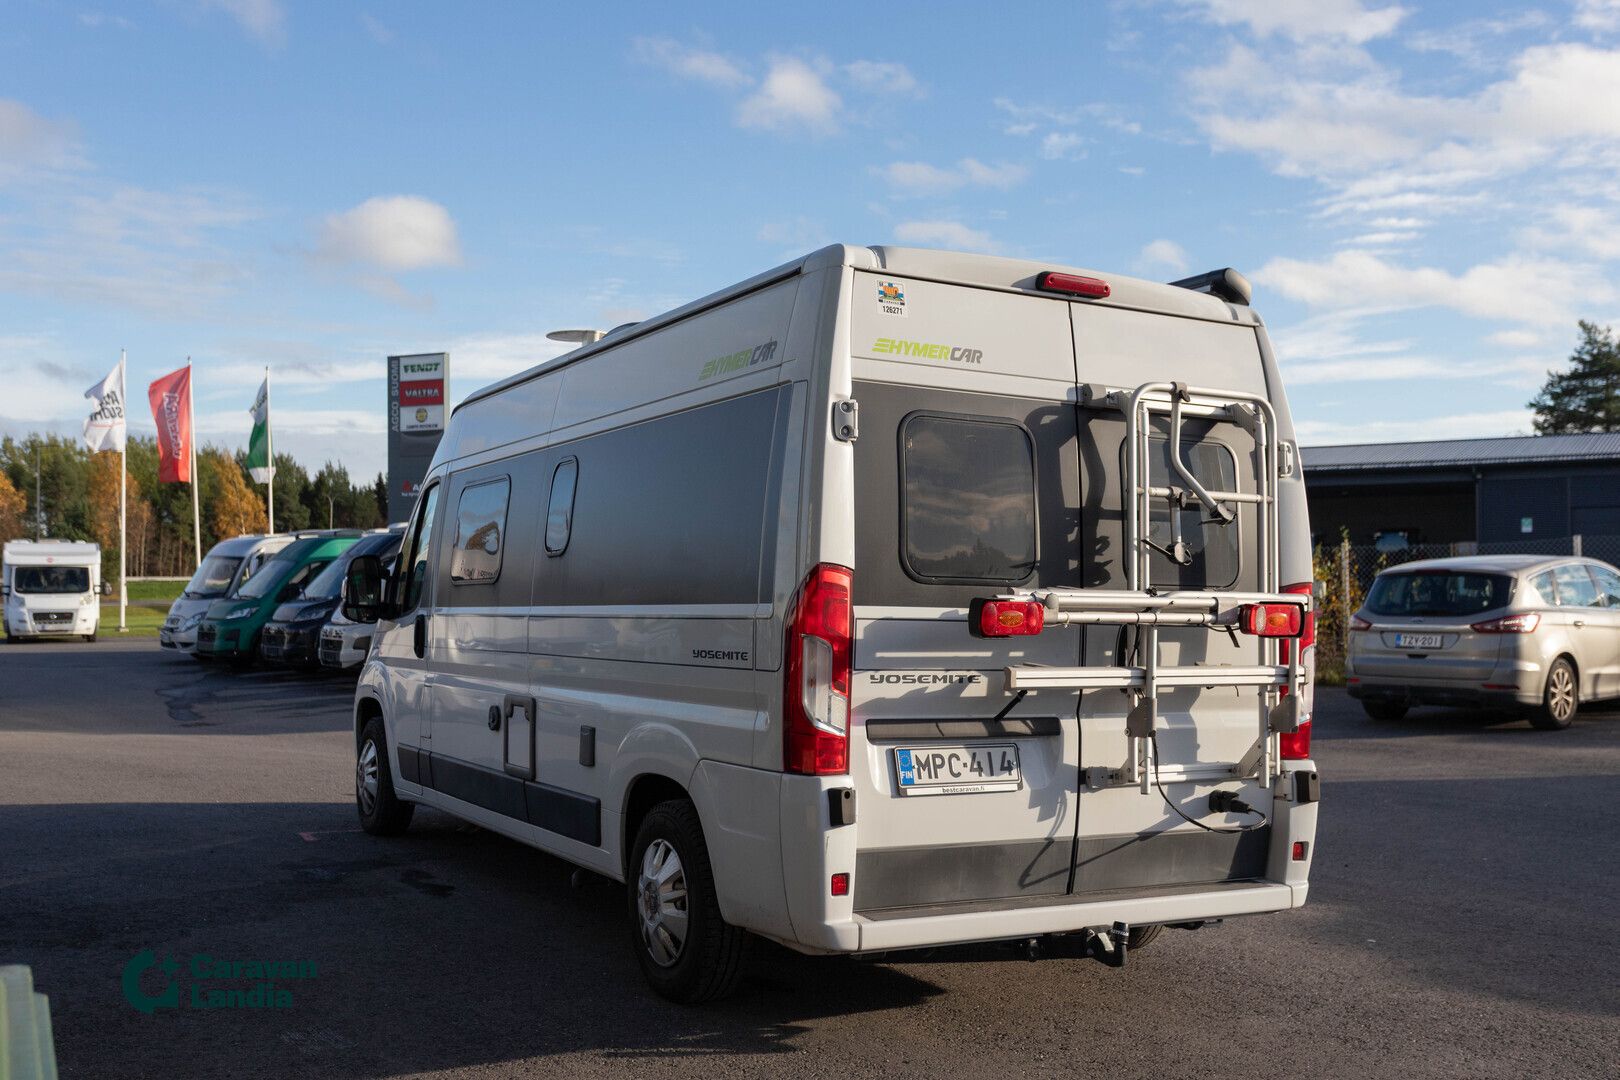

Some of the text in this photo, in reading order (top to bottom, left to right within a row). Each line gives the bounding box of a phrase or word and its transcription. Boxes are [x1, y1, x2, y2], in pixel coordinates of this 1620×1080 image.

[882, 305, 903, 316] 126271
[874, 338, 983, 365] HYMERCAR
[403, 362, 441, 373] FENDT
[405, 388, 439, 398] VALTRA
[692, 649, 749, 661] YOSEMITE
[870, 674, 982, 685] YOSEMITE
[914, 751, 1014, 780] MPC-414
[942, 785, 985, 794] bestcaravan.fi
